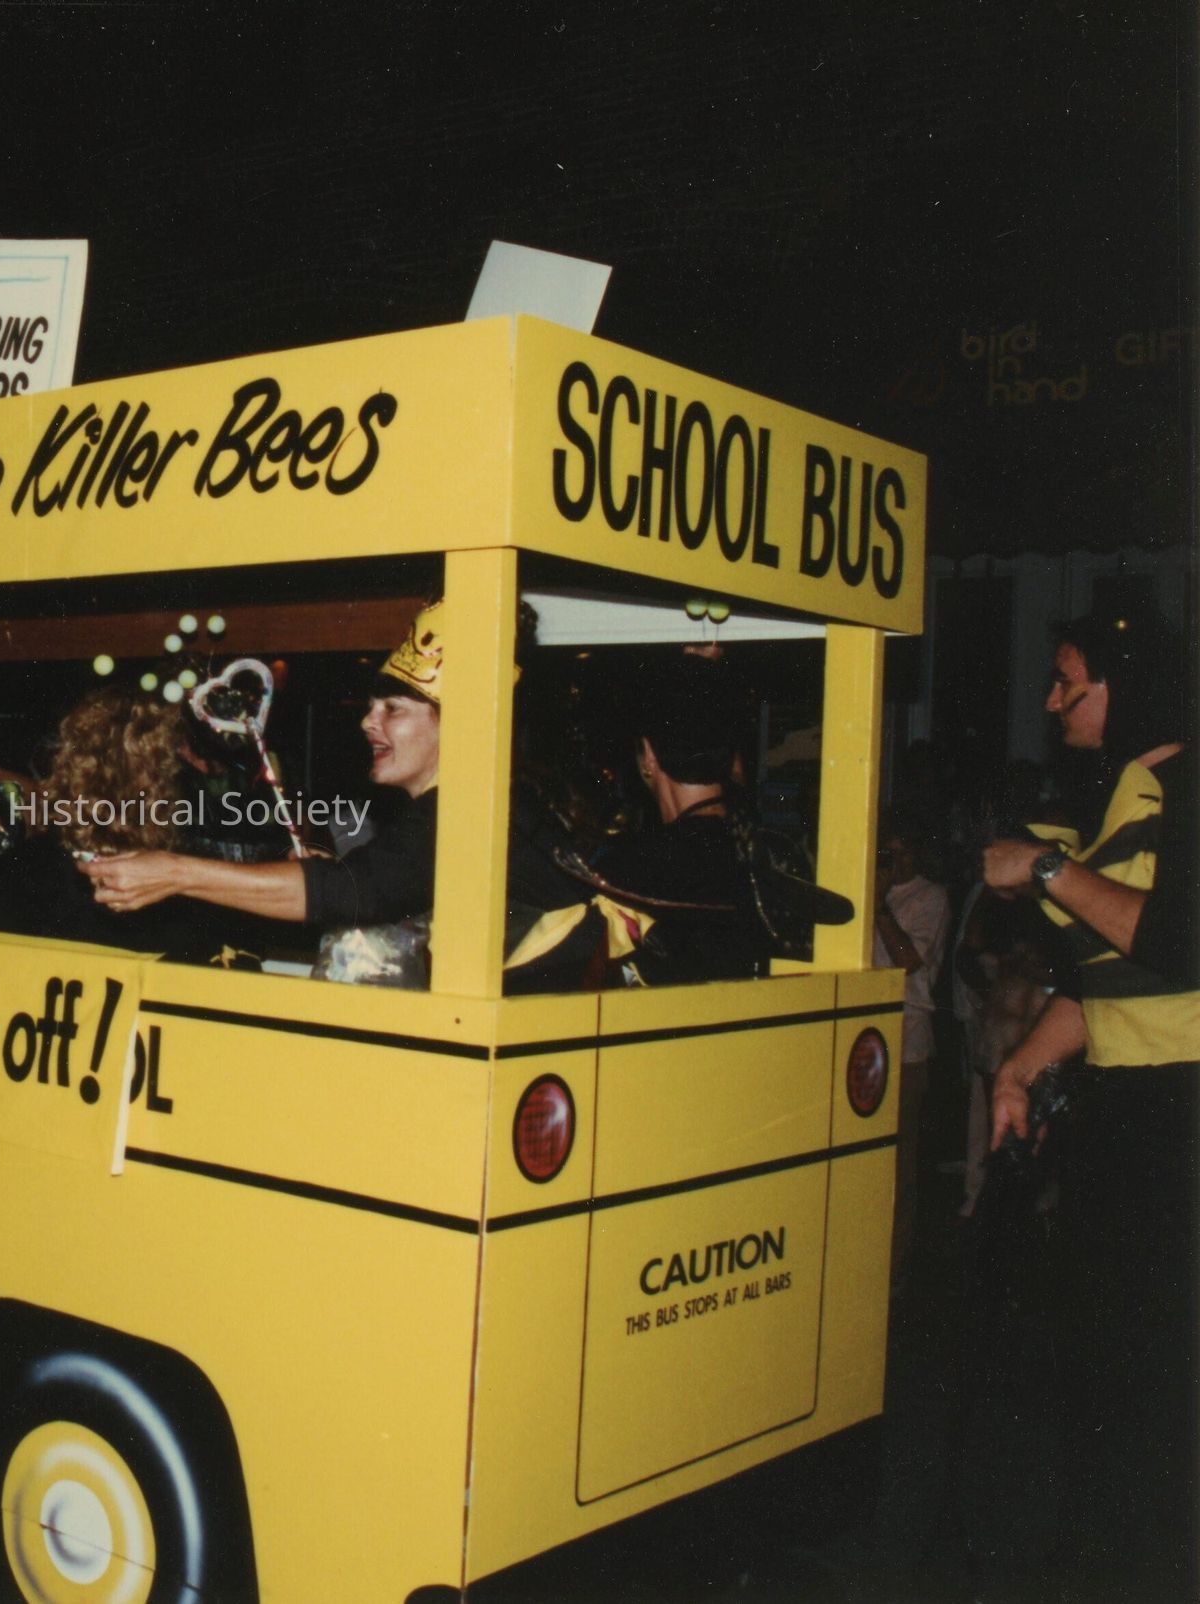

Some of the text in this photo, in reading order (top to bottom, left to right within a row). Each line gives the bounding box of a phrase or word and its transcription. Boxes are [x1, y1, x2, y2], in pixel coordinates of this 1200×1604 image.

[960, 319, 1037, 361] bird
[986, 362, 1089, 407] hand
[11, 400, 198, 519] Killer
[194, 377, 399, 500] Bees
[552, 360, 907, 600] SCHOOL BUS
[639, 1225, 786, 1296] CAUTION
[624, 1271, 792, 1336] THIS BUS STOPS AT ALL BARS
